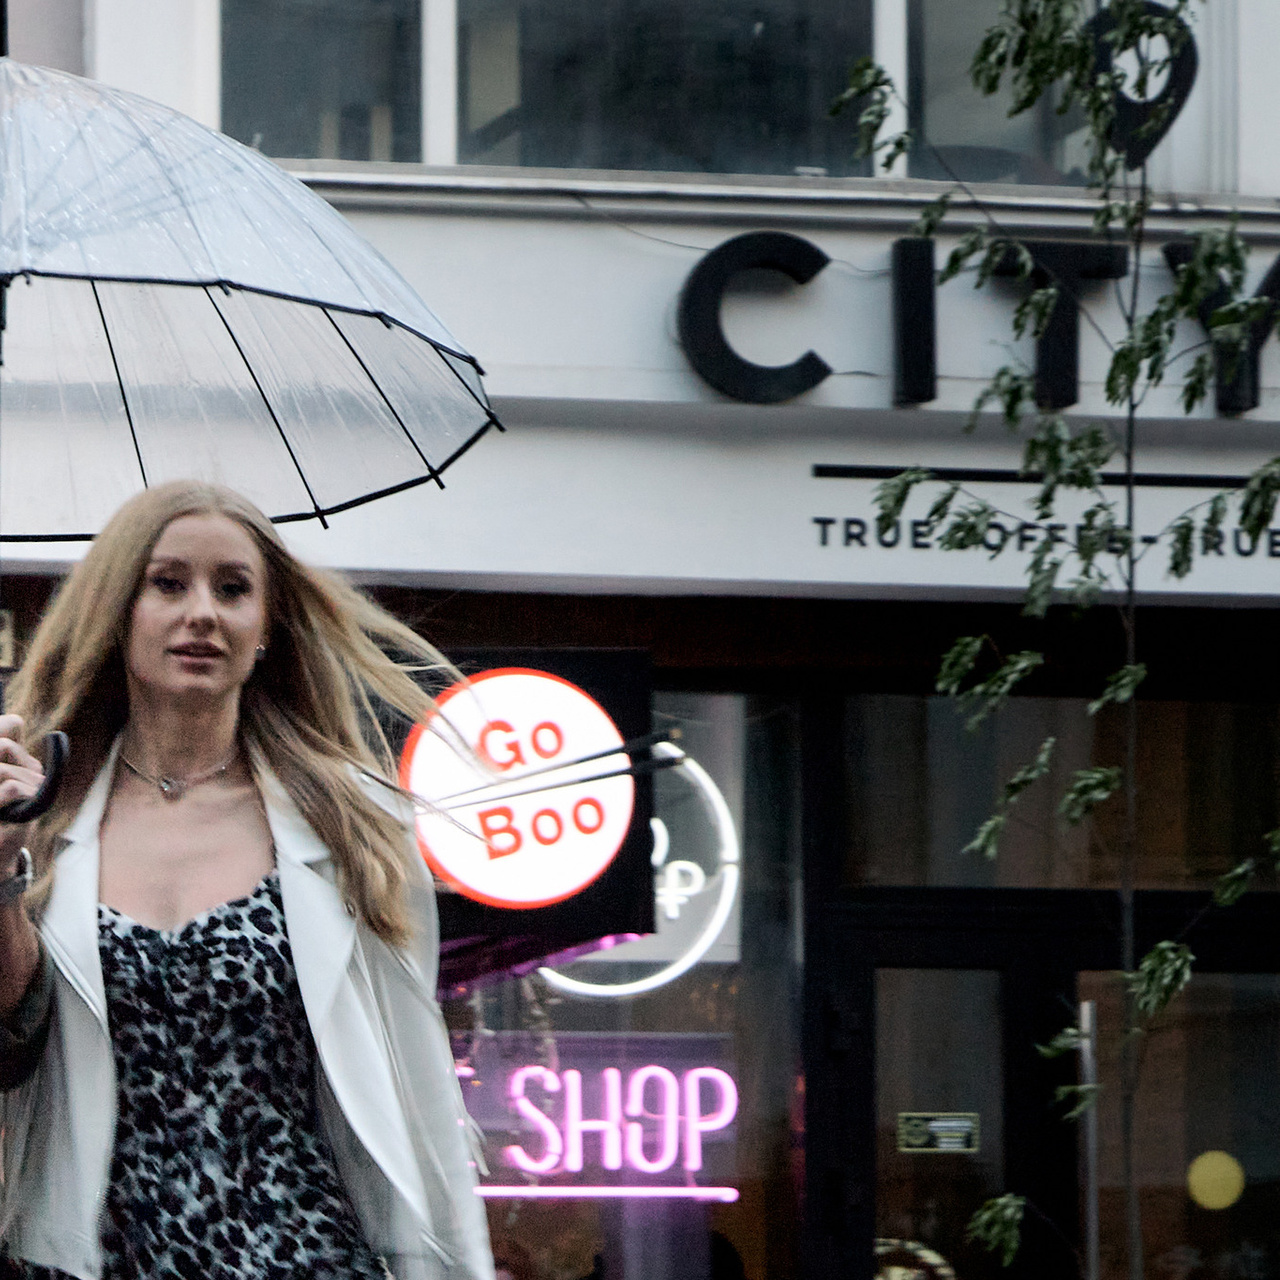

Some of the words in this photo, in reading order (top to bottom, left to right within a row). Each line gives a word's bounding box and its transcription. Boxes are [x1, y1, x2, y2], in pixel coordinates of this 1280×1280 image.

[812, 516, 933, 549] TRUE
[1171, 526, 1280, 558] RUE
[477, 719, 564, 772] Go
[477, 796, 605, 862] Boo
[505, 1063, 739, 1175] SHOP
